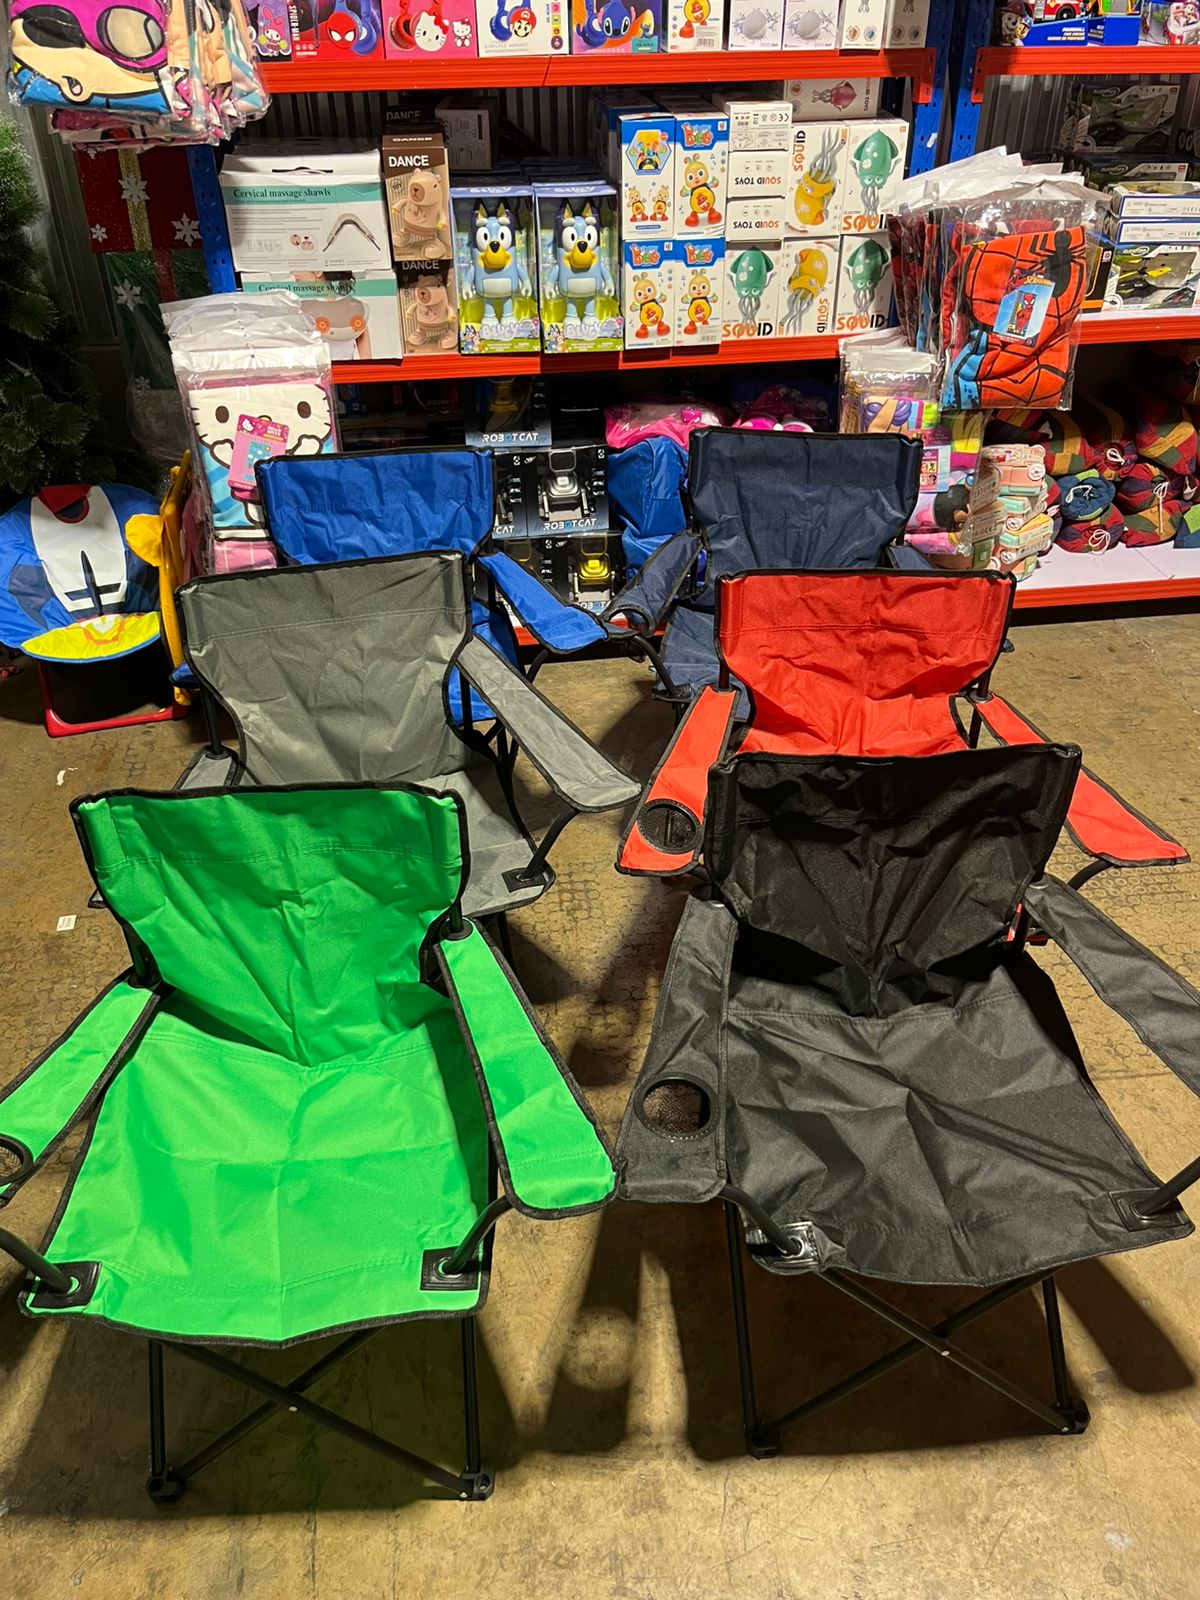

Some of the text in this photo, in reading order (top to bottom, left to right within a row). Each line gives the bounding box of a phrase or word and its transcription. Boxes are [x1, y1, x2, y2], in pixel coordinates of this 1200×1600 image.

[386, 111, 420, 120] DANCE
[794, 130, 806, 171] SQUID
[388, 155, 429, 167] DANCE
[233, 188, 331, 198] Cervical massage shawls
[842, 214, 889, 232] SQUI
[402, 261, 440, 270] DANCE
[293, 284, 325, 293] massage
[817, 298, 828, 333] SQUID
[837, 315, 886, 331] SQUID
[722, 323, 773, 338] SQUID
[495, 526, 514, 534] CAT
